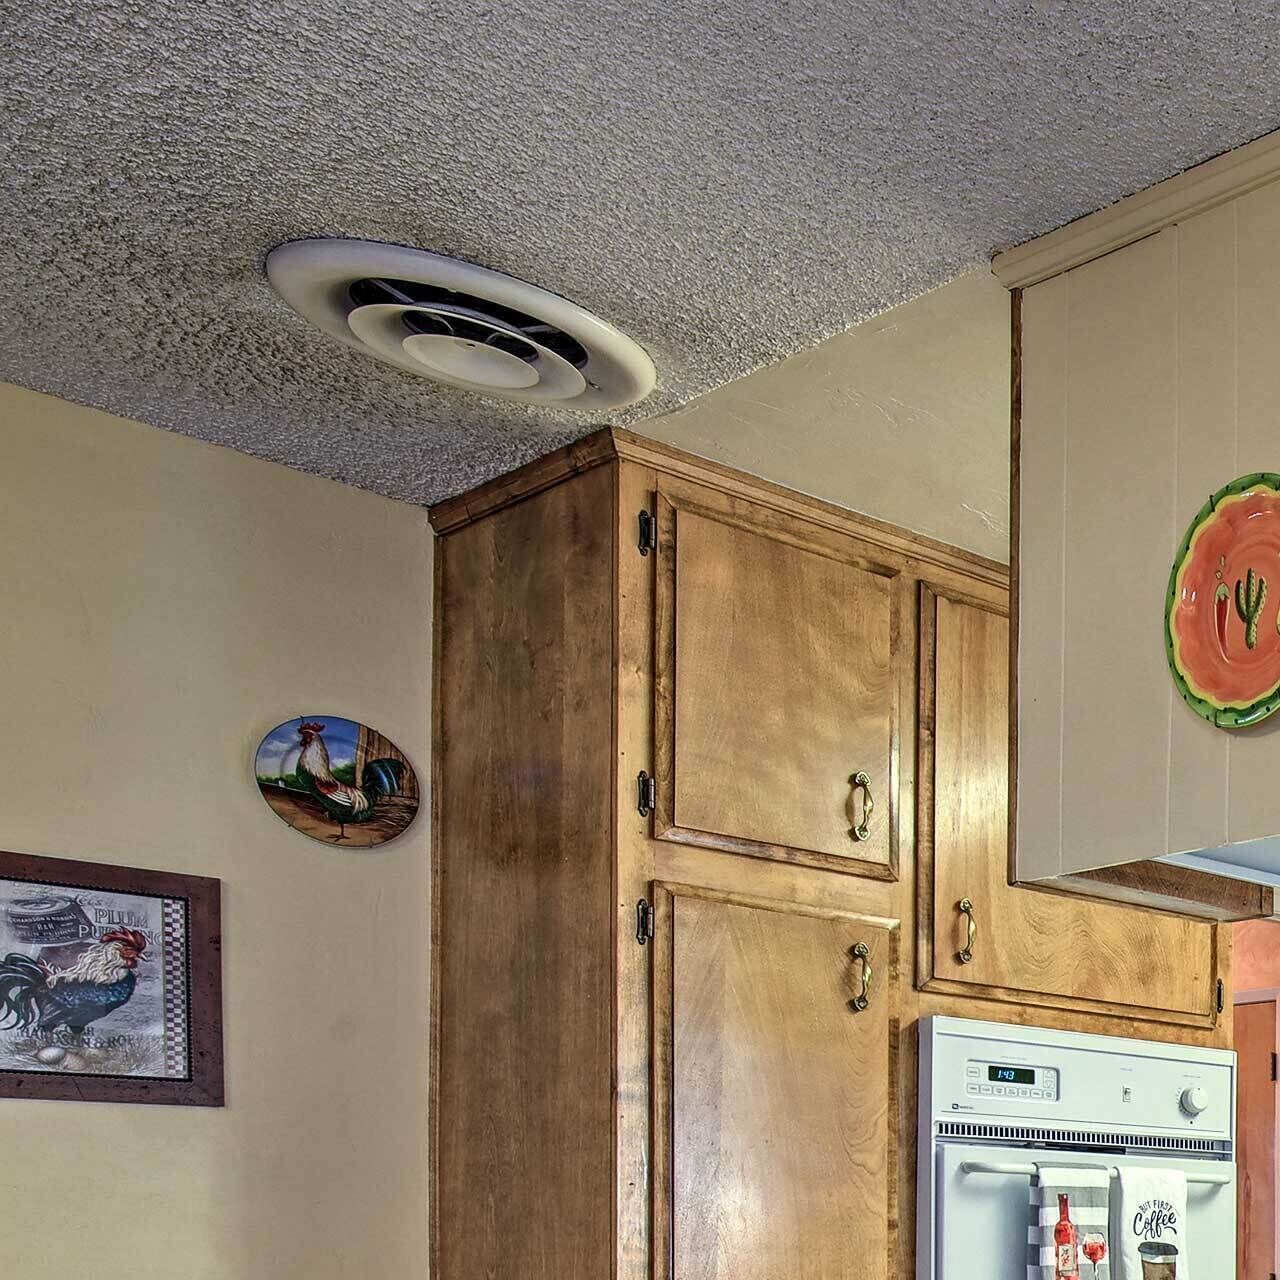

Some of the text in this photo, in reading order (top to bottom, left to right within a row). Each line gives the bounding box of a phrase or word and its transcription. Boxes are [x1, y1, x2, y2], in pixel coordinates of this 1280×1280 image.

[997, 1070, 1015, 1080] 1:43
[1153, 1200, 1173, 1212] FIRST
[1133, 1210, 1177, 1240] Coffee
